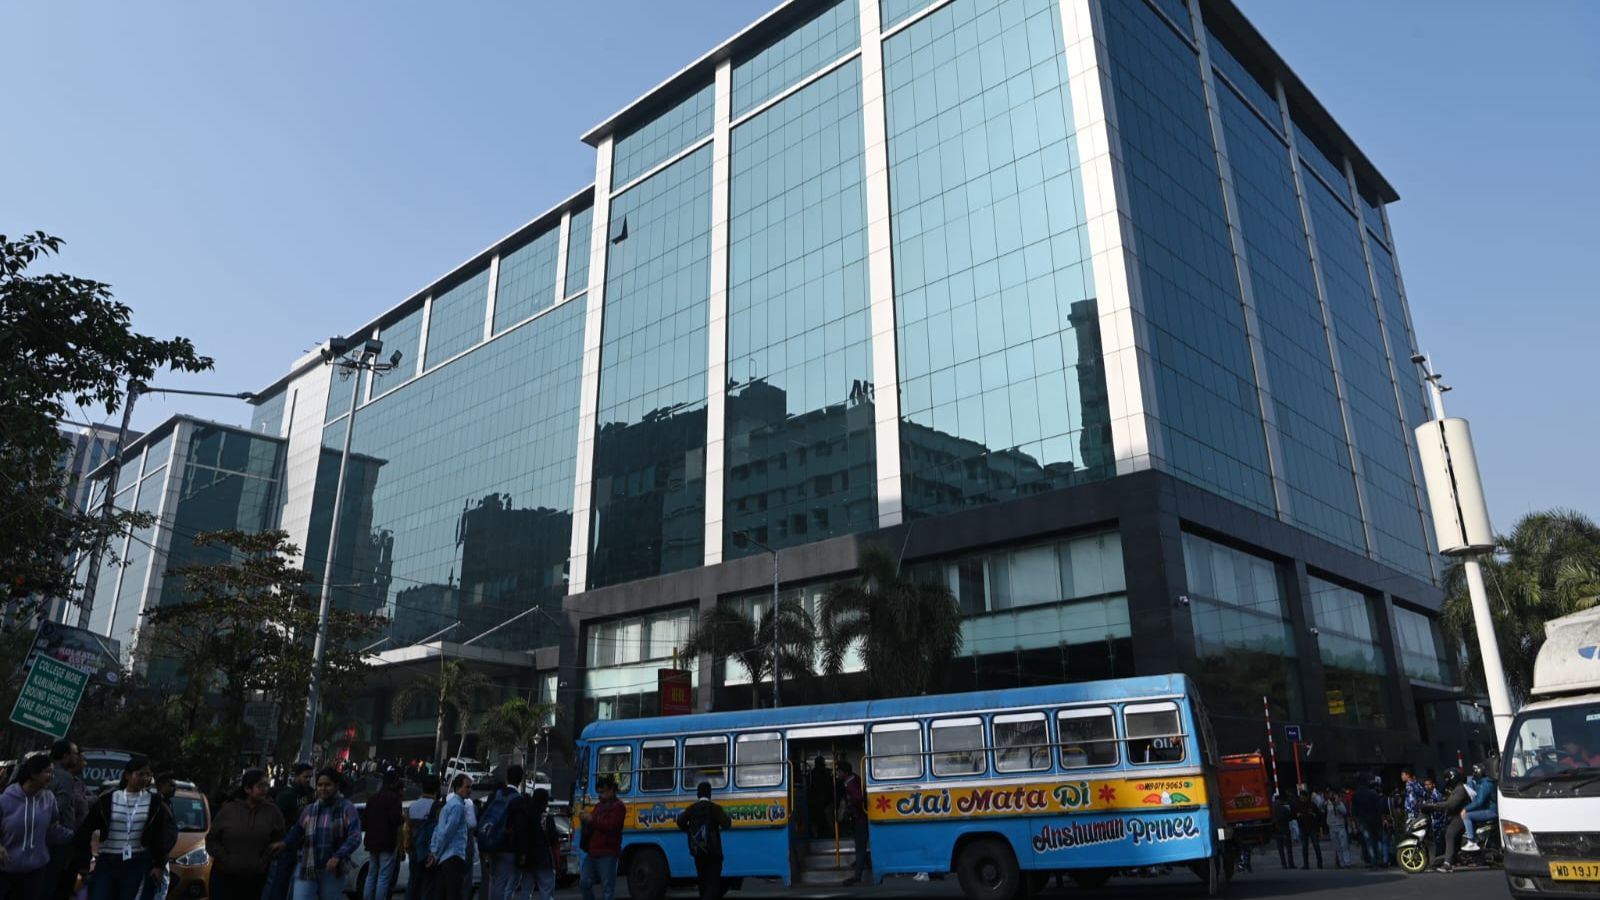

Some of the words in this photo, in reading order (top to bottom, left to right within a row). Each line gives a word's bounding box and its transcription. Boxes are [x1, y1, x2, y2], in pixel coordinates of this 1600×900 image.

[38, 660, 66, 678] COLLEGE
[64, 670, 82, 685] MORE
[24, 684, 47, 701] BOUND
[46, 692, 75, 712] VEHICLES
[33, 674, 77, 700] KARUNAMOYEE
[17, 697, 36, 711] TAKE
[34, 703, 54, 718] RIGHT
[53, 710, 70, 723] TURN
[957, 786, 1048, 813] Mata
[1053, 781, 1091, 808] Di
[1032, 817, 1125, 853] Anshuman
[1126, 815, 1200, 845] Prince
